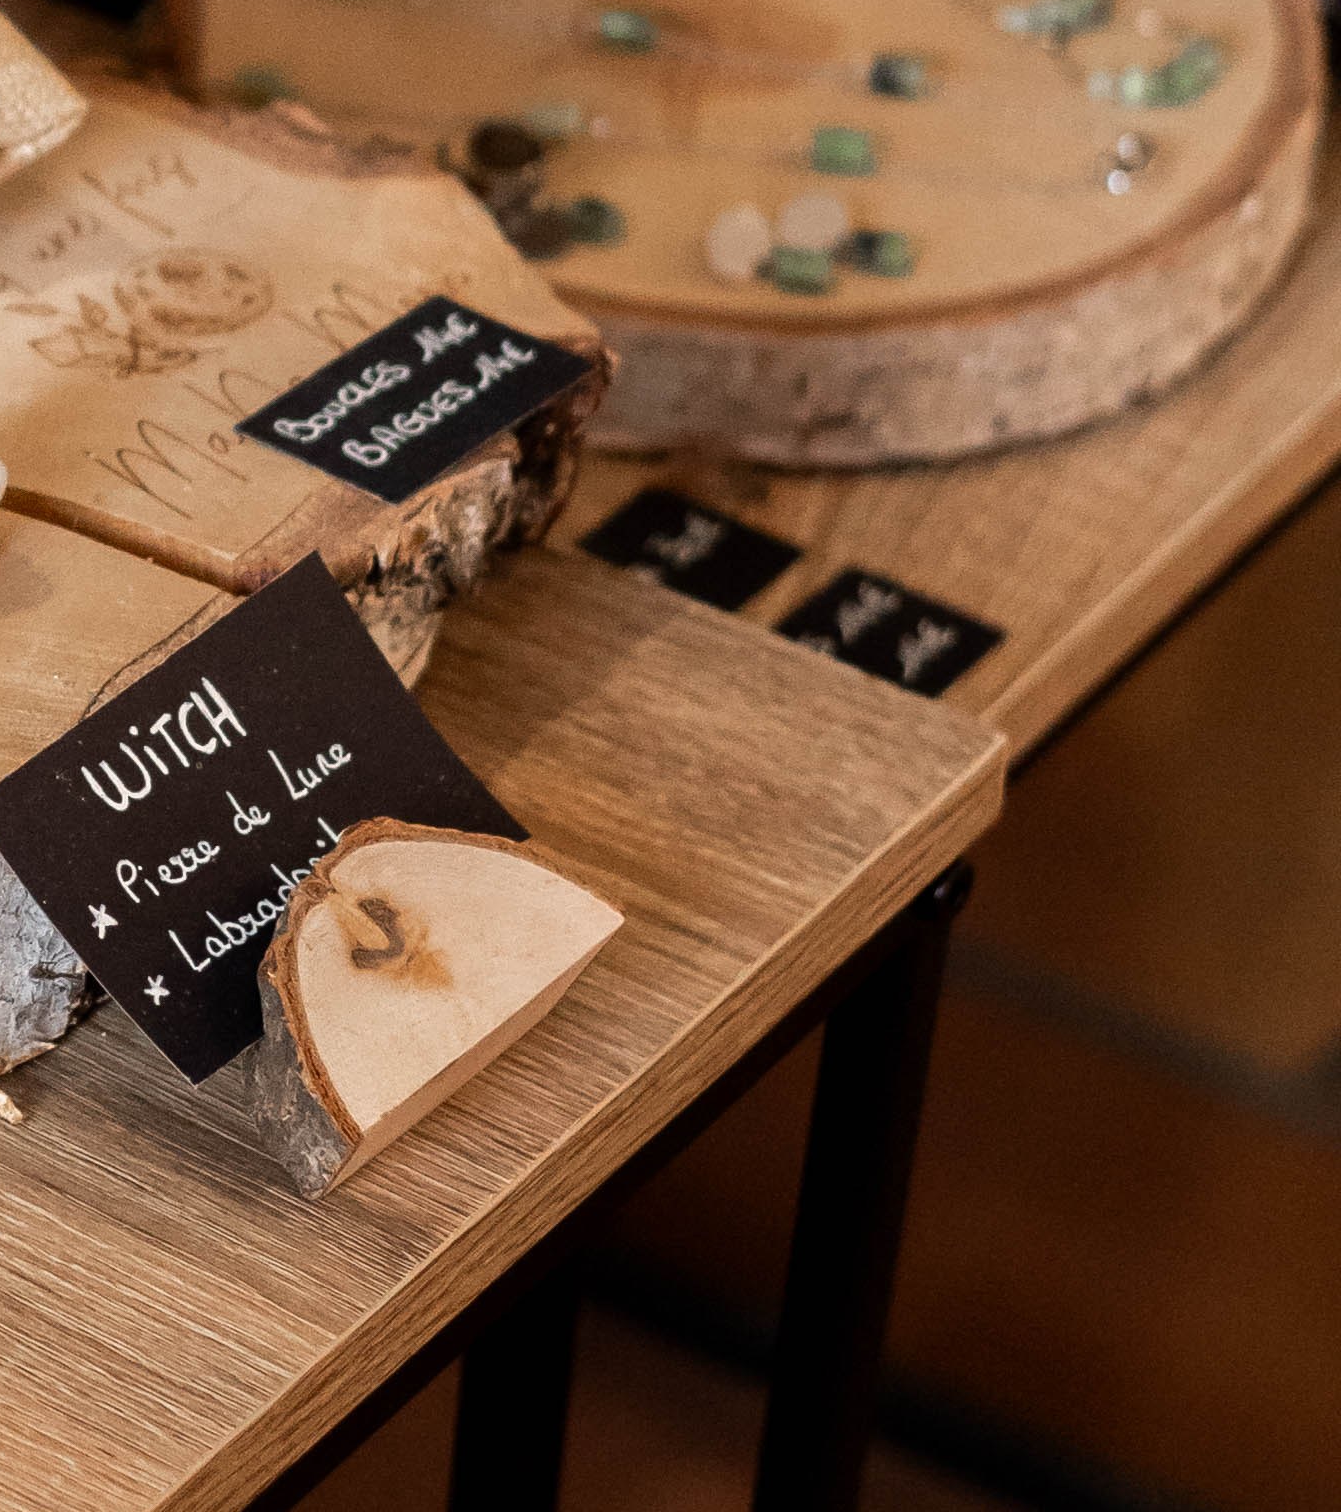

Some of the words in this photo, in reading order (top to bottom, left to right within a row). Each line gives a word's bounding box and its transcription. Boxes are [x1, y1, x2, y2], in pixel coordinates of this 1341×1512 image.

[116, 839, 220, 904] Pierre
[225, 790, 271, 836] de
[267, 742, 352, 801] Lune
